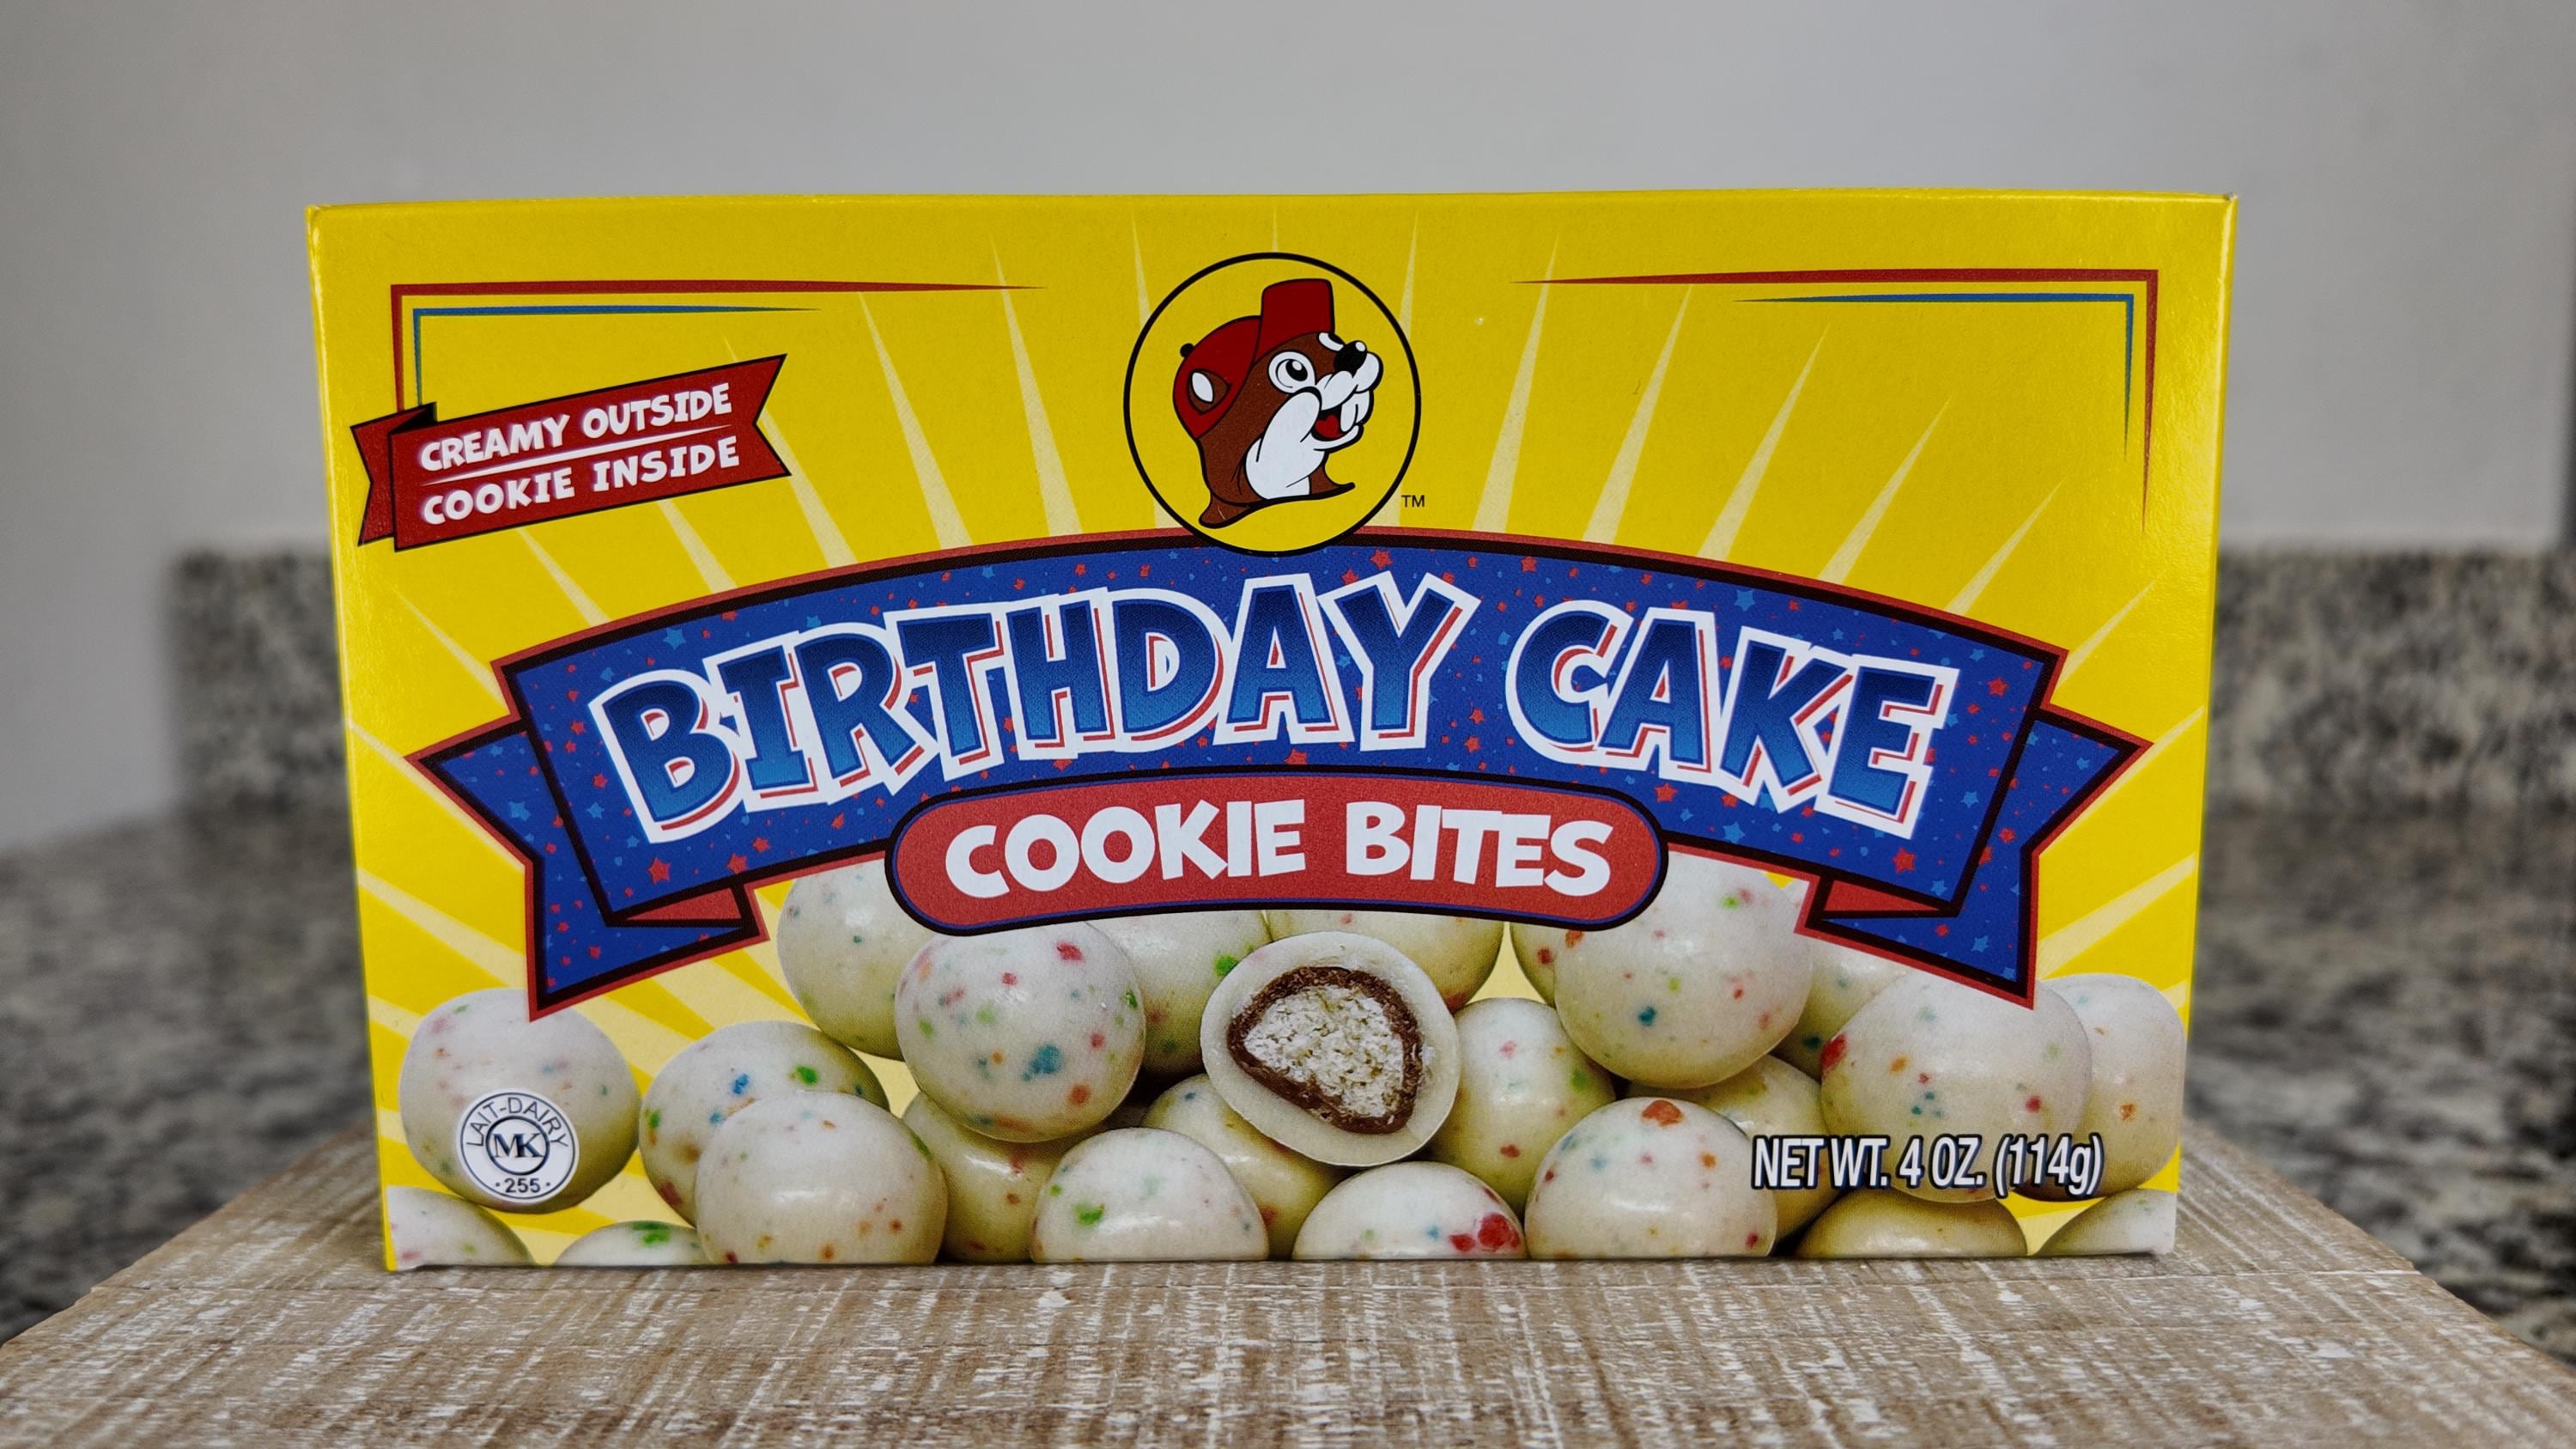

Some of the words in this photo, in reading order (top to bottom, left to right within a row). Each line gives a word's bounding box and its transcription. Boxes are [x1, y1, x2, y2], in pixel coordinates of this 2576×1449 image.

[421, 414, 570, 472] CREAMY
[582, 382, 732, 435] OUTSIDE
[422, 467, 575, 525] COOKIE
[593, 435, 740, 491] INSIDE
[589, 570, 1481, 843] BIRTHDAY
[1504, 600, 1959, 840] CAKE
[945, 798, 1305, 897] COOKIE
[1345, 801, 1613, 896] BITES
[466, 1096, 569, 1148] LAIT-DAIRY
[1753, 1136, 1825, 1189] NET
[1830, 1135, 1888, 1188] WT.
[1899, 1135, 1922, 1187] 4
[1930, 1135, 1985, 1187] OZ.
[1994, 1133, 2104, 1198] (114g)
